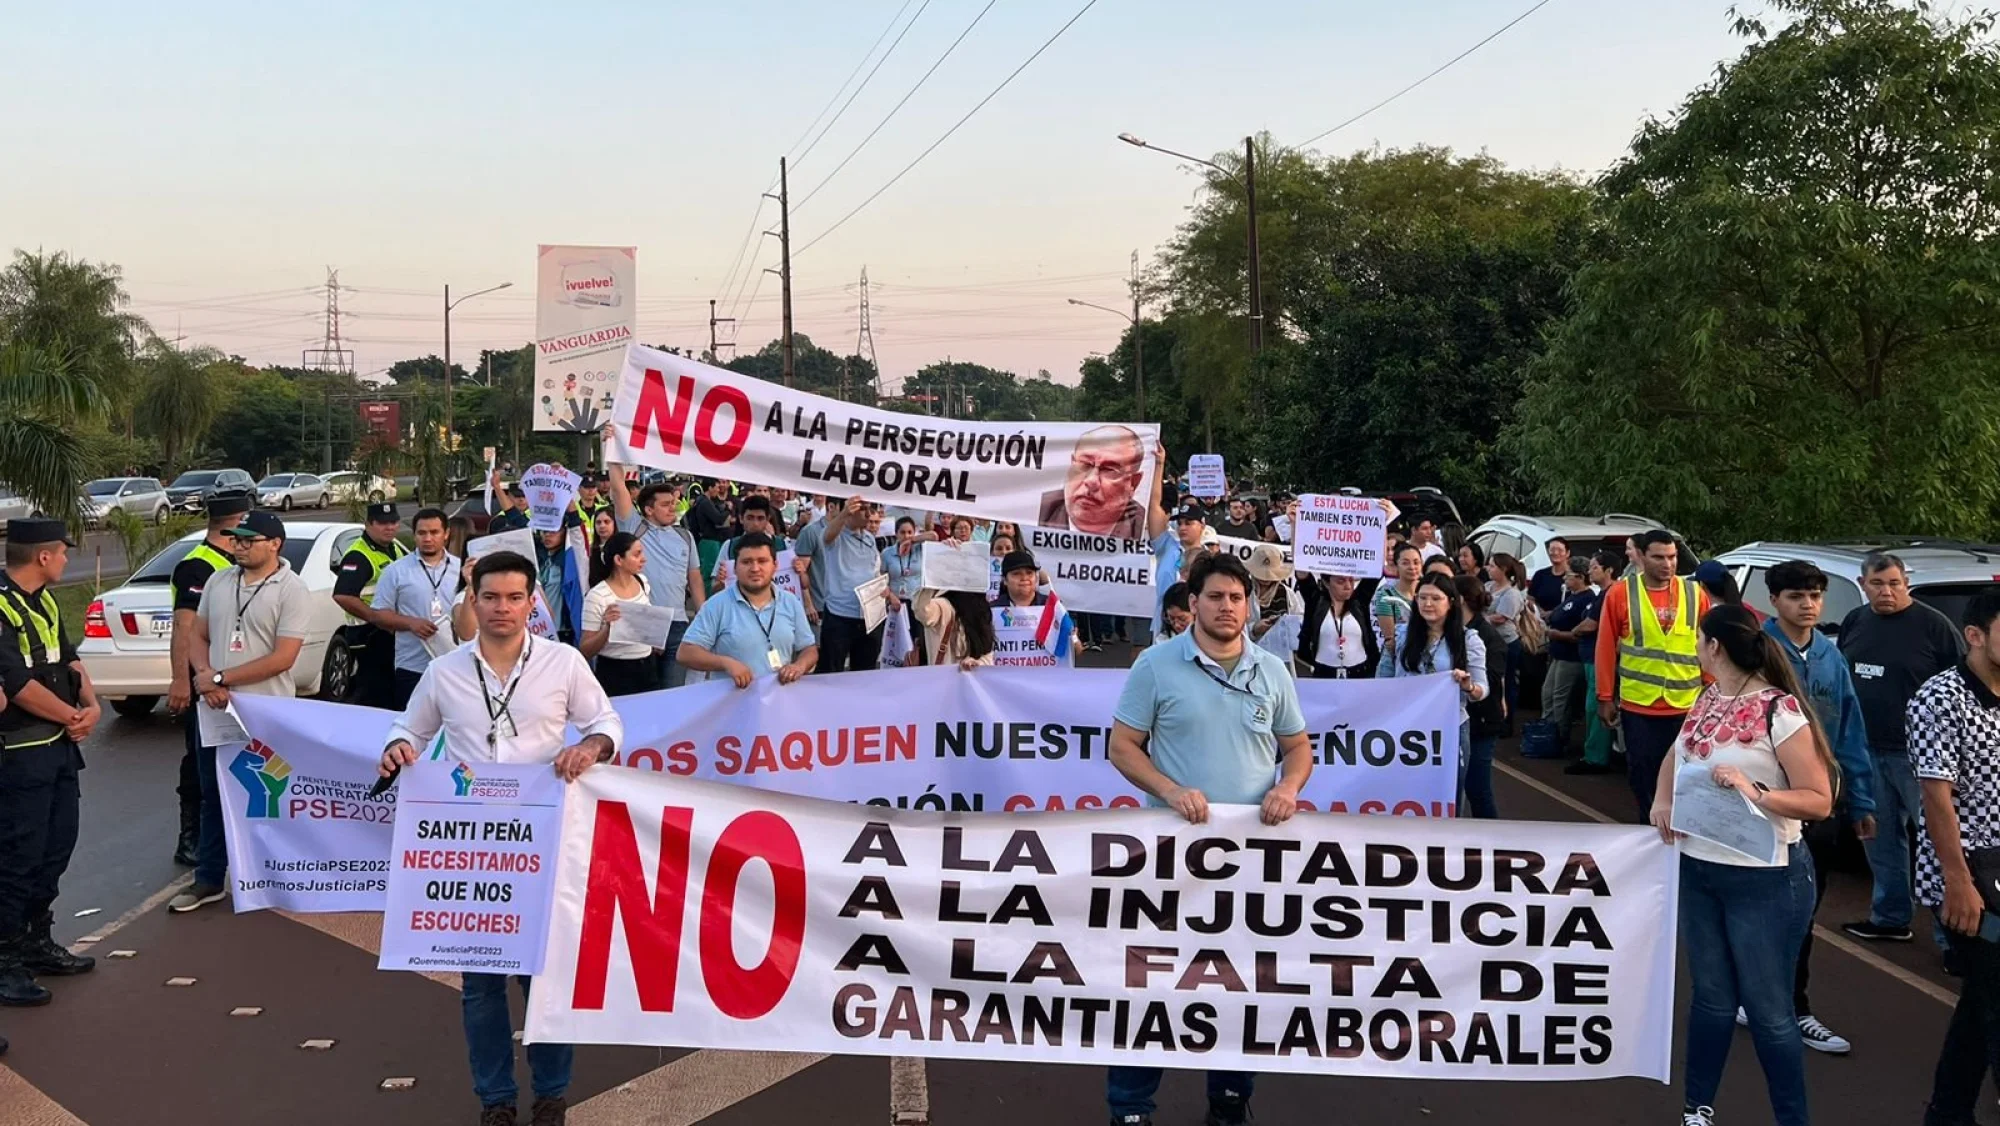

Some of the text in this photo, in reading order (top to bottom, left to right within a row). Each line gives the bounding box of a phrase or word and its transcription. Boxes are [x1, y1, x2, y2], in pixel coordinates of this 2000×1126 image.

[540, 325, 631, 354] VANGUARDIA
[629, 368, 1046, 470] NO A LA PERSECUCIÓN
[801, 449, 976, 502] LABORAL
[1314, 497, 1369, 511] ESTA LUCHA
[1300, 511, 1382, 529] TAMBIEN ES TUYA,
[1033, 531, 1117, 553] EXIGIMOS
[1318, 528, 1361, 543] FUTURO
[1303, 545, 1375, 561] CONCURSANTE!!
[1057, 562, 1148, 585] LABORALE
[993, 640, 1018, 651] ANTI
[715, 724, 917, 775] SAQUEN
[935, 722, 1111, 760] NUEST
[297, 776, 329, 786] FRENTE
[331, 780, 341, 788] DE
[471, 787, 518, 798] PSE2023
[290, 784, 398, 804] CONTRATADO
[289, 799, 396, 824] PSE202
[417, 818, 533, 842] SANTI PEÑA
[403, 850, 540, 873] NECESITAMOS
[426, 881, 512, 902] QUE NOS
[570, 799, 1612, 1020] NO A LA DICTADURA
[838, 876, 1613, 950] A LA INJUSTICIA
[411, 911, 520, 934] ESCUCHES!
[431, 945, 502, 956] #JusticiaPSE2023
[408, 957, 520, 969] #QueremosJusticiaPSE2023
[835, 934, 1609, 1005] A LA FALTA DE
[831, 983, 1612, 1065] GARANTIAS LABORALES
